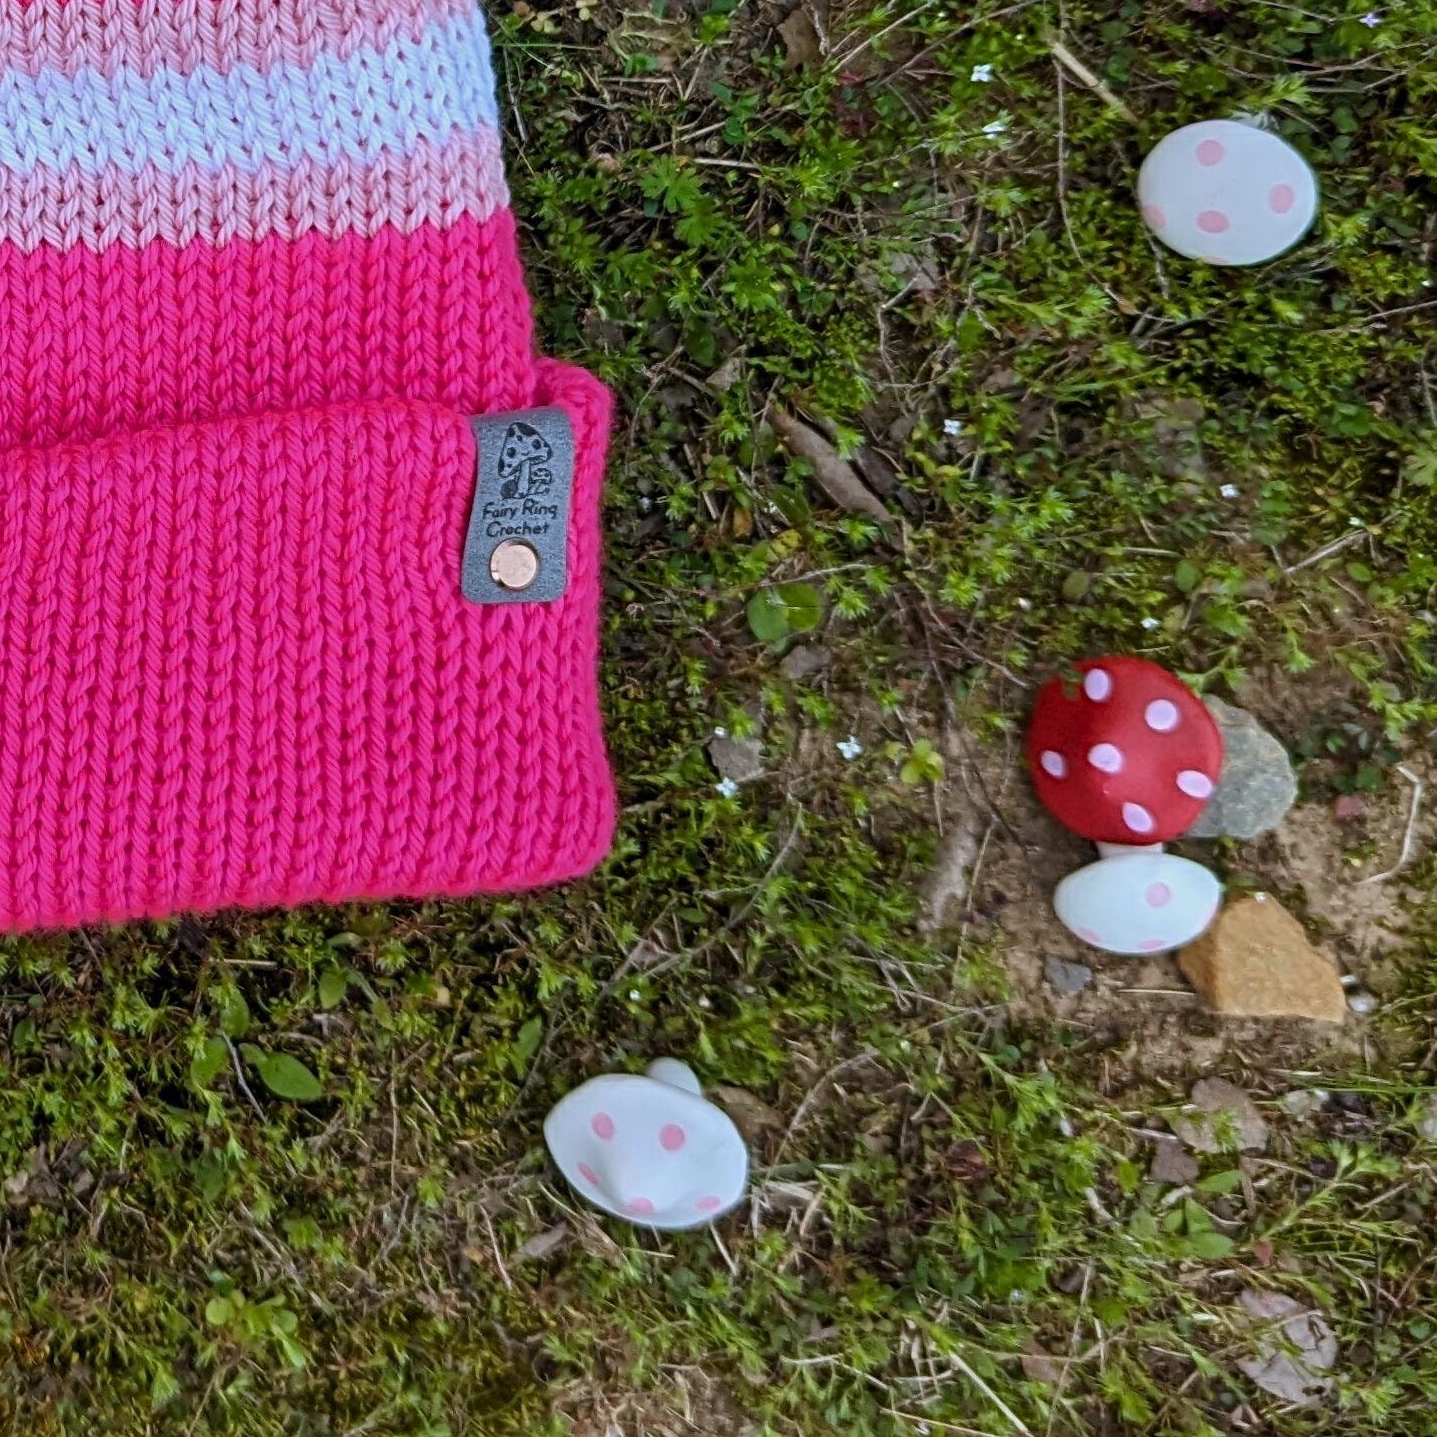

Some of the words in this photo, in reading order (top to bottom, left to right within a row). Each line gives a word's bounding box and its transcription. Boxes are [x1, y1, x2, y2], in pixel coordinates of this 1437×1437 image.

[483, 501, 517, 520] Fairy
[522, 498, 558, 519] Ring
[486, 521, 549, 537] Crochet
